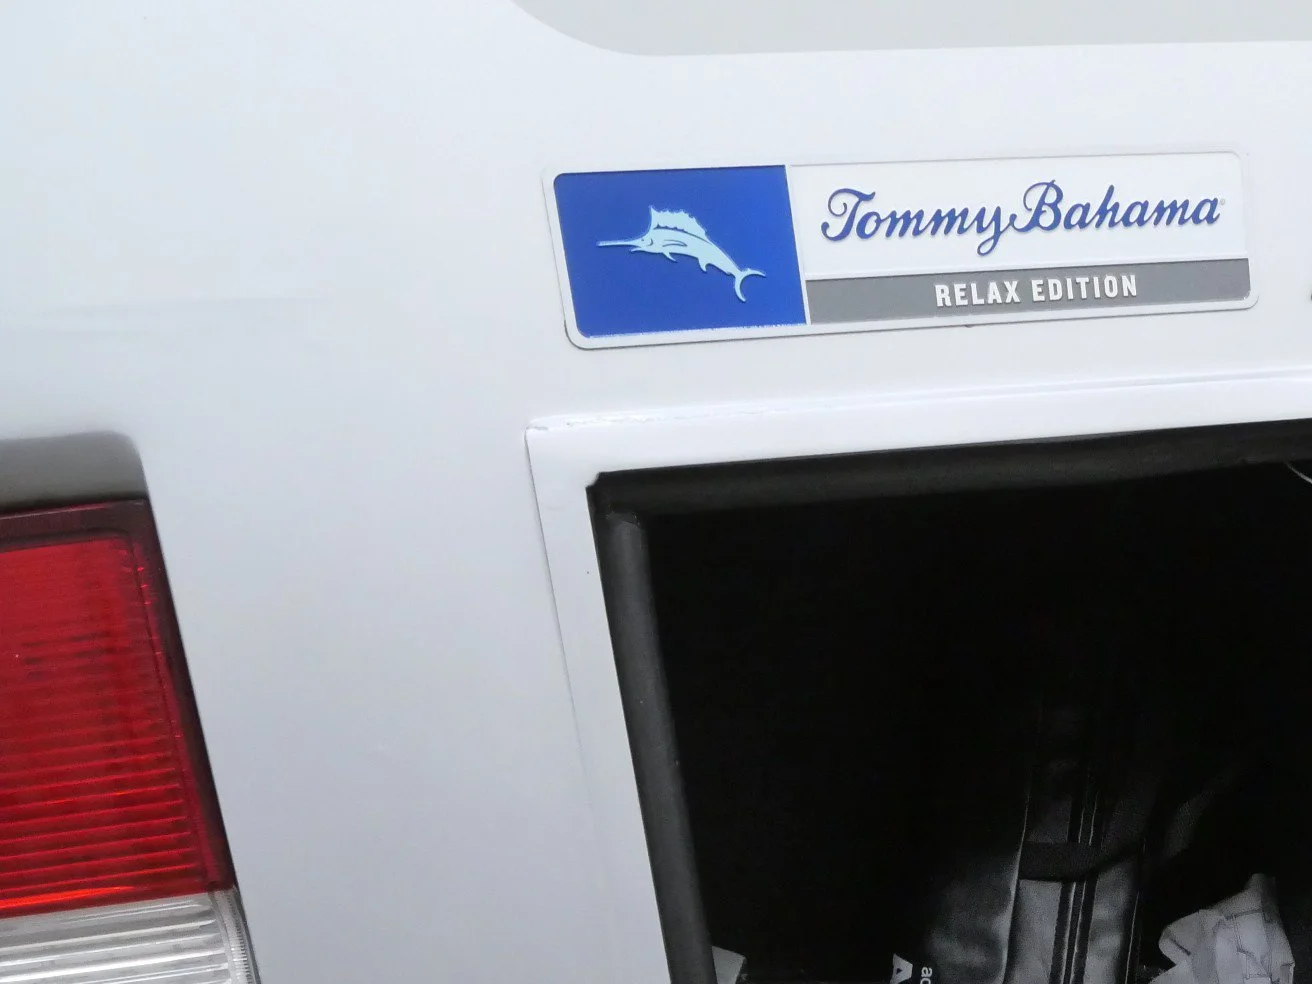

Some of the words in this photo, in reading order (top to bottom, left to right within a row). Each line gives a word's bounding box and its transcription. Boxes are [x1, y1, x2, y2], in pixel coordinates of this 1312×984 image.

[821, 187, 1012, 257] Tommy
[1010, 179, 1221, 234] Bahama
[933, 280, 1022, 308] RELAX
[1031, 274, 1138, 302] EDITION
